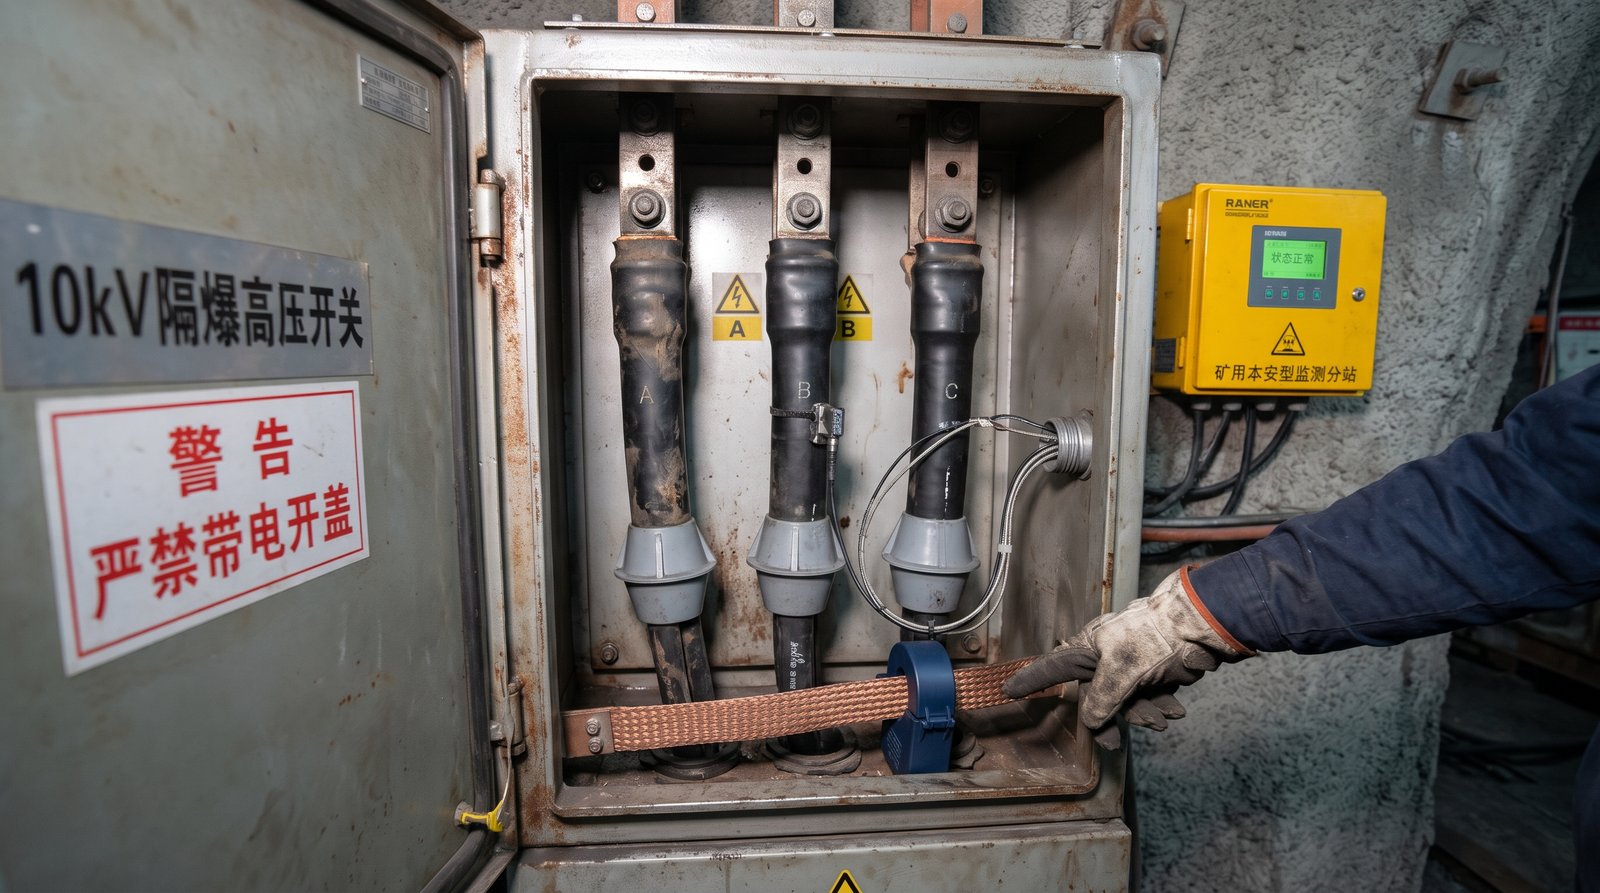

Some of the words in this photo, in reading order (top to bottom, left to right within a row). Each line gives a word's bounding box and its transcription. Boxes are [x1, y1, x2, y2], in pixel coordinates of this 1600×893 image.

[1225, 198, 1269, 209] RANER
[1271, 251, 1314, 265] 状态正常
[16, 261, 365, 350] 10kV隔爆高压开关
[729, 320, 746, 337] A
[841, 320, 856, 337] B
[1214, 364, 1358, 383] 矿用本安型监测分站
[639, 385, 655, 405] A
[797, 381, 811, 399] B
[945, 382, 958, 400] C
[90, 482, 354, 620] 严禁带电开盖
